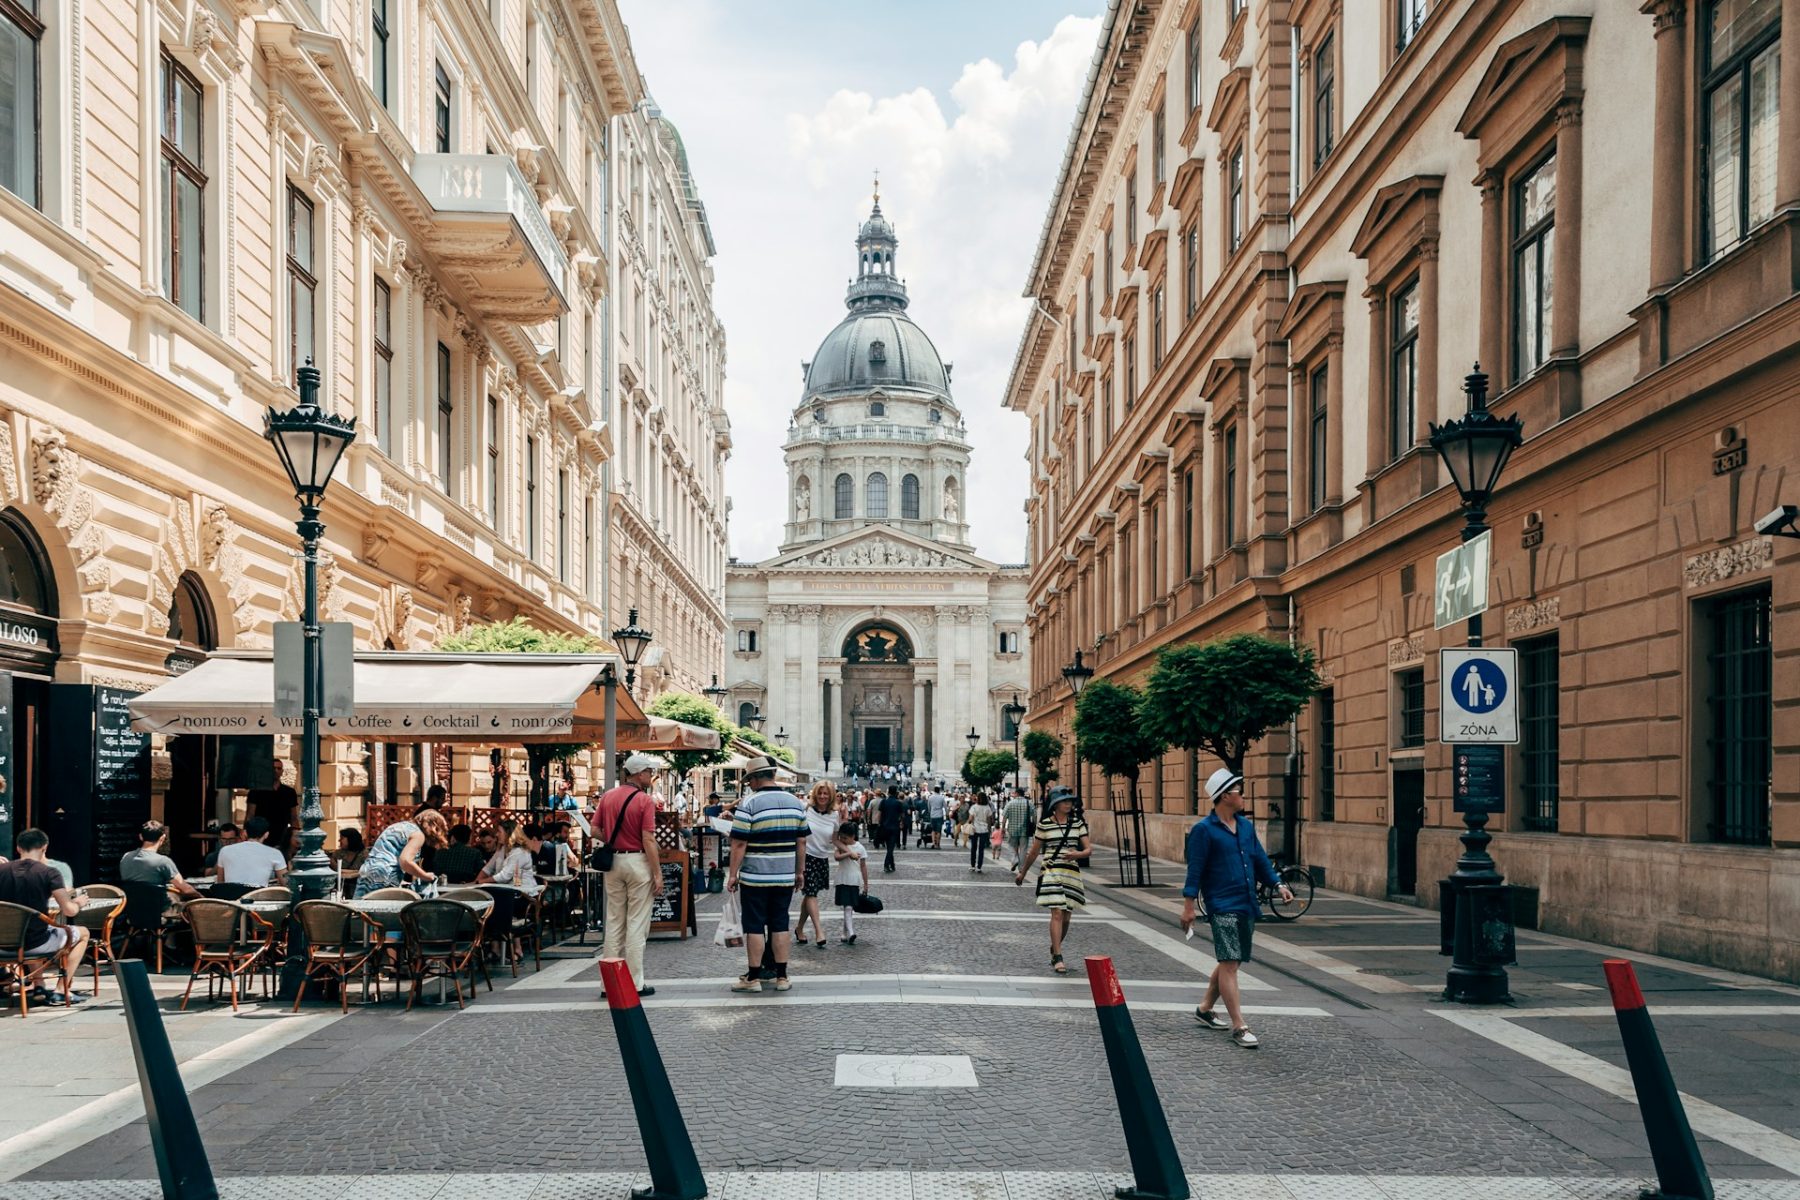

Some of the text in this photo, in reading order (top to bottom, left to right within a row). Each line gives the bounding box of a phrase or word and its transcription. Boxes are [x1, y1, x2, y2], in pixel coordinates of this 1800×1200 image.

[348, 714, 392, 728] Coffee
[423, 714, 480, 728] Cocktail
[1460, 721, 1498, 735] ZÓNA
